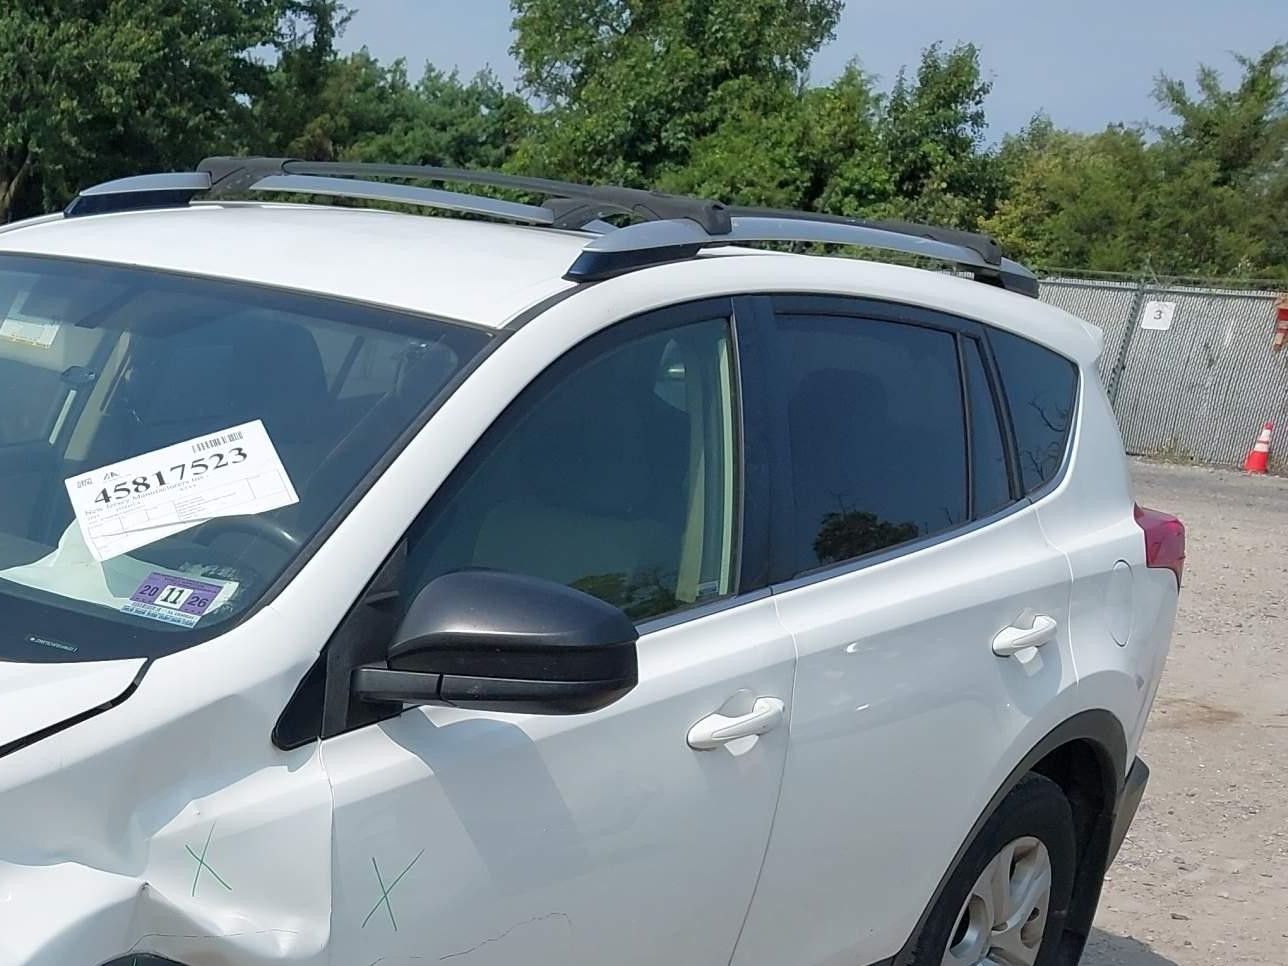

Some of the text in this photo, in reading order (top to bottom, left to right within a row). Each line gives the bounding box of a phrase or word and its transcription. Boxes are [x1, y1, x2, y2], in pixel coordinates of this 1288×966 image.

[1153, 309, 1163, 320] 3
[94, 447, 248, 504] 45817523
[139, 584, 159, 597] 20
[160, 587, 185, 605] 11
[187, 596, 209, 608] 26
